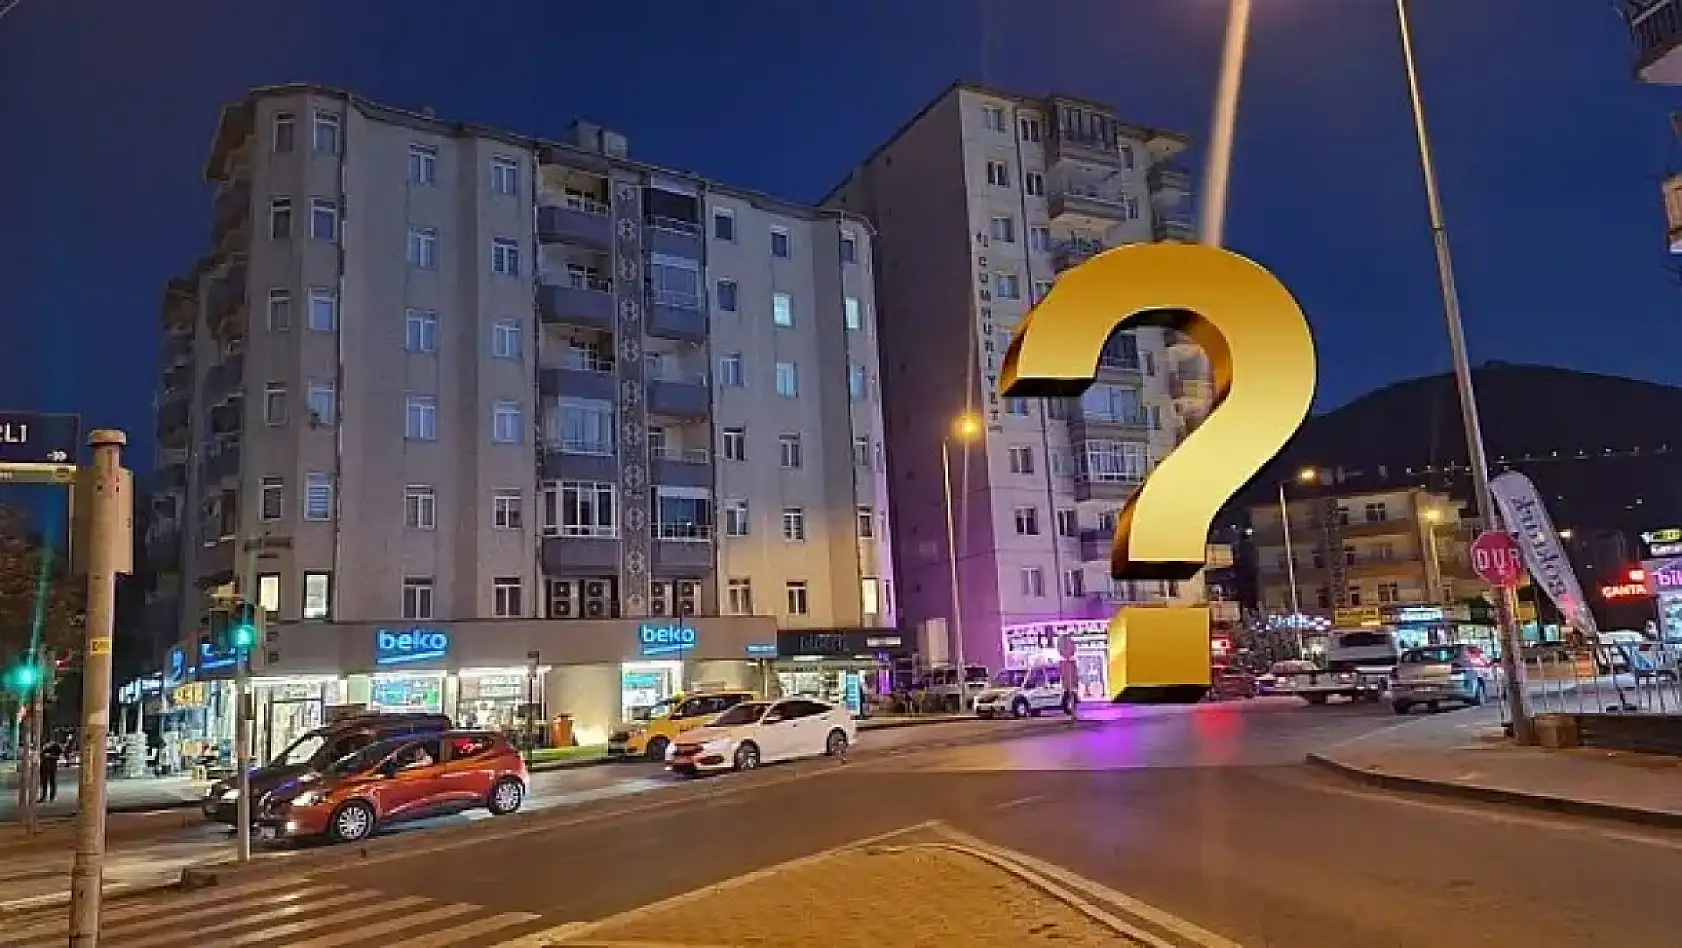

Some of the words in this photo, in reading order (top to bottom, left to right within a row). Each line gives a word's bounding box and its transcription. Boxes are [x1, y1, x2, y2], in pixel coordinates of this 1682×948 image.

[1476, 548, 1521, 570] DUR
[379, 629, 447, 649] beko
[643, 623, 695, 642] beko
